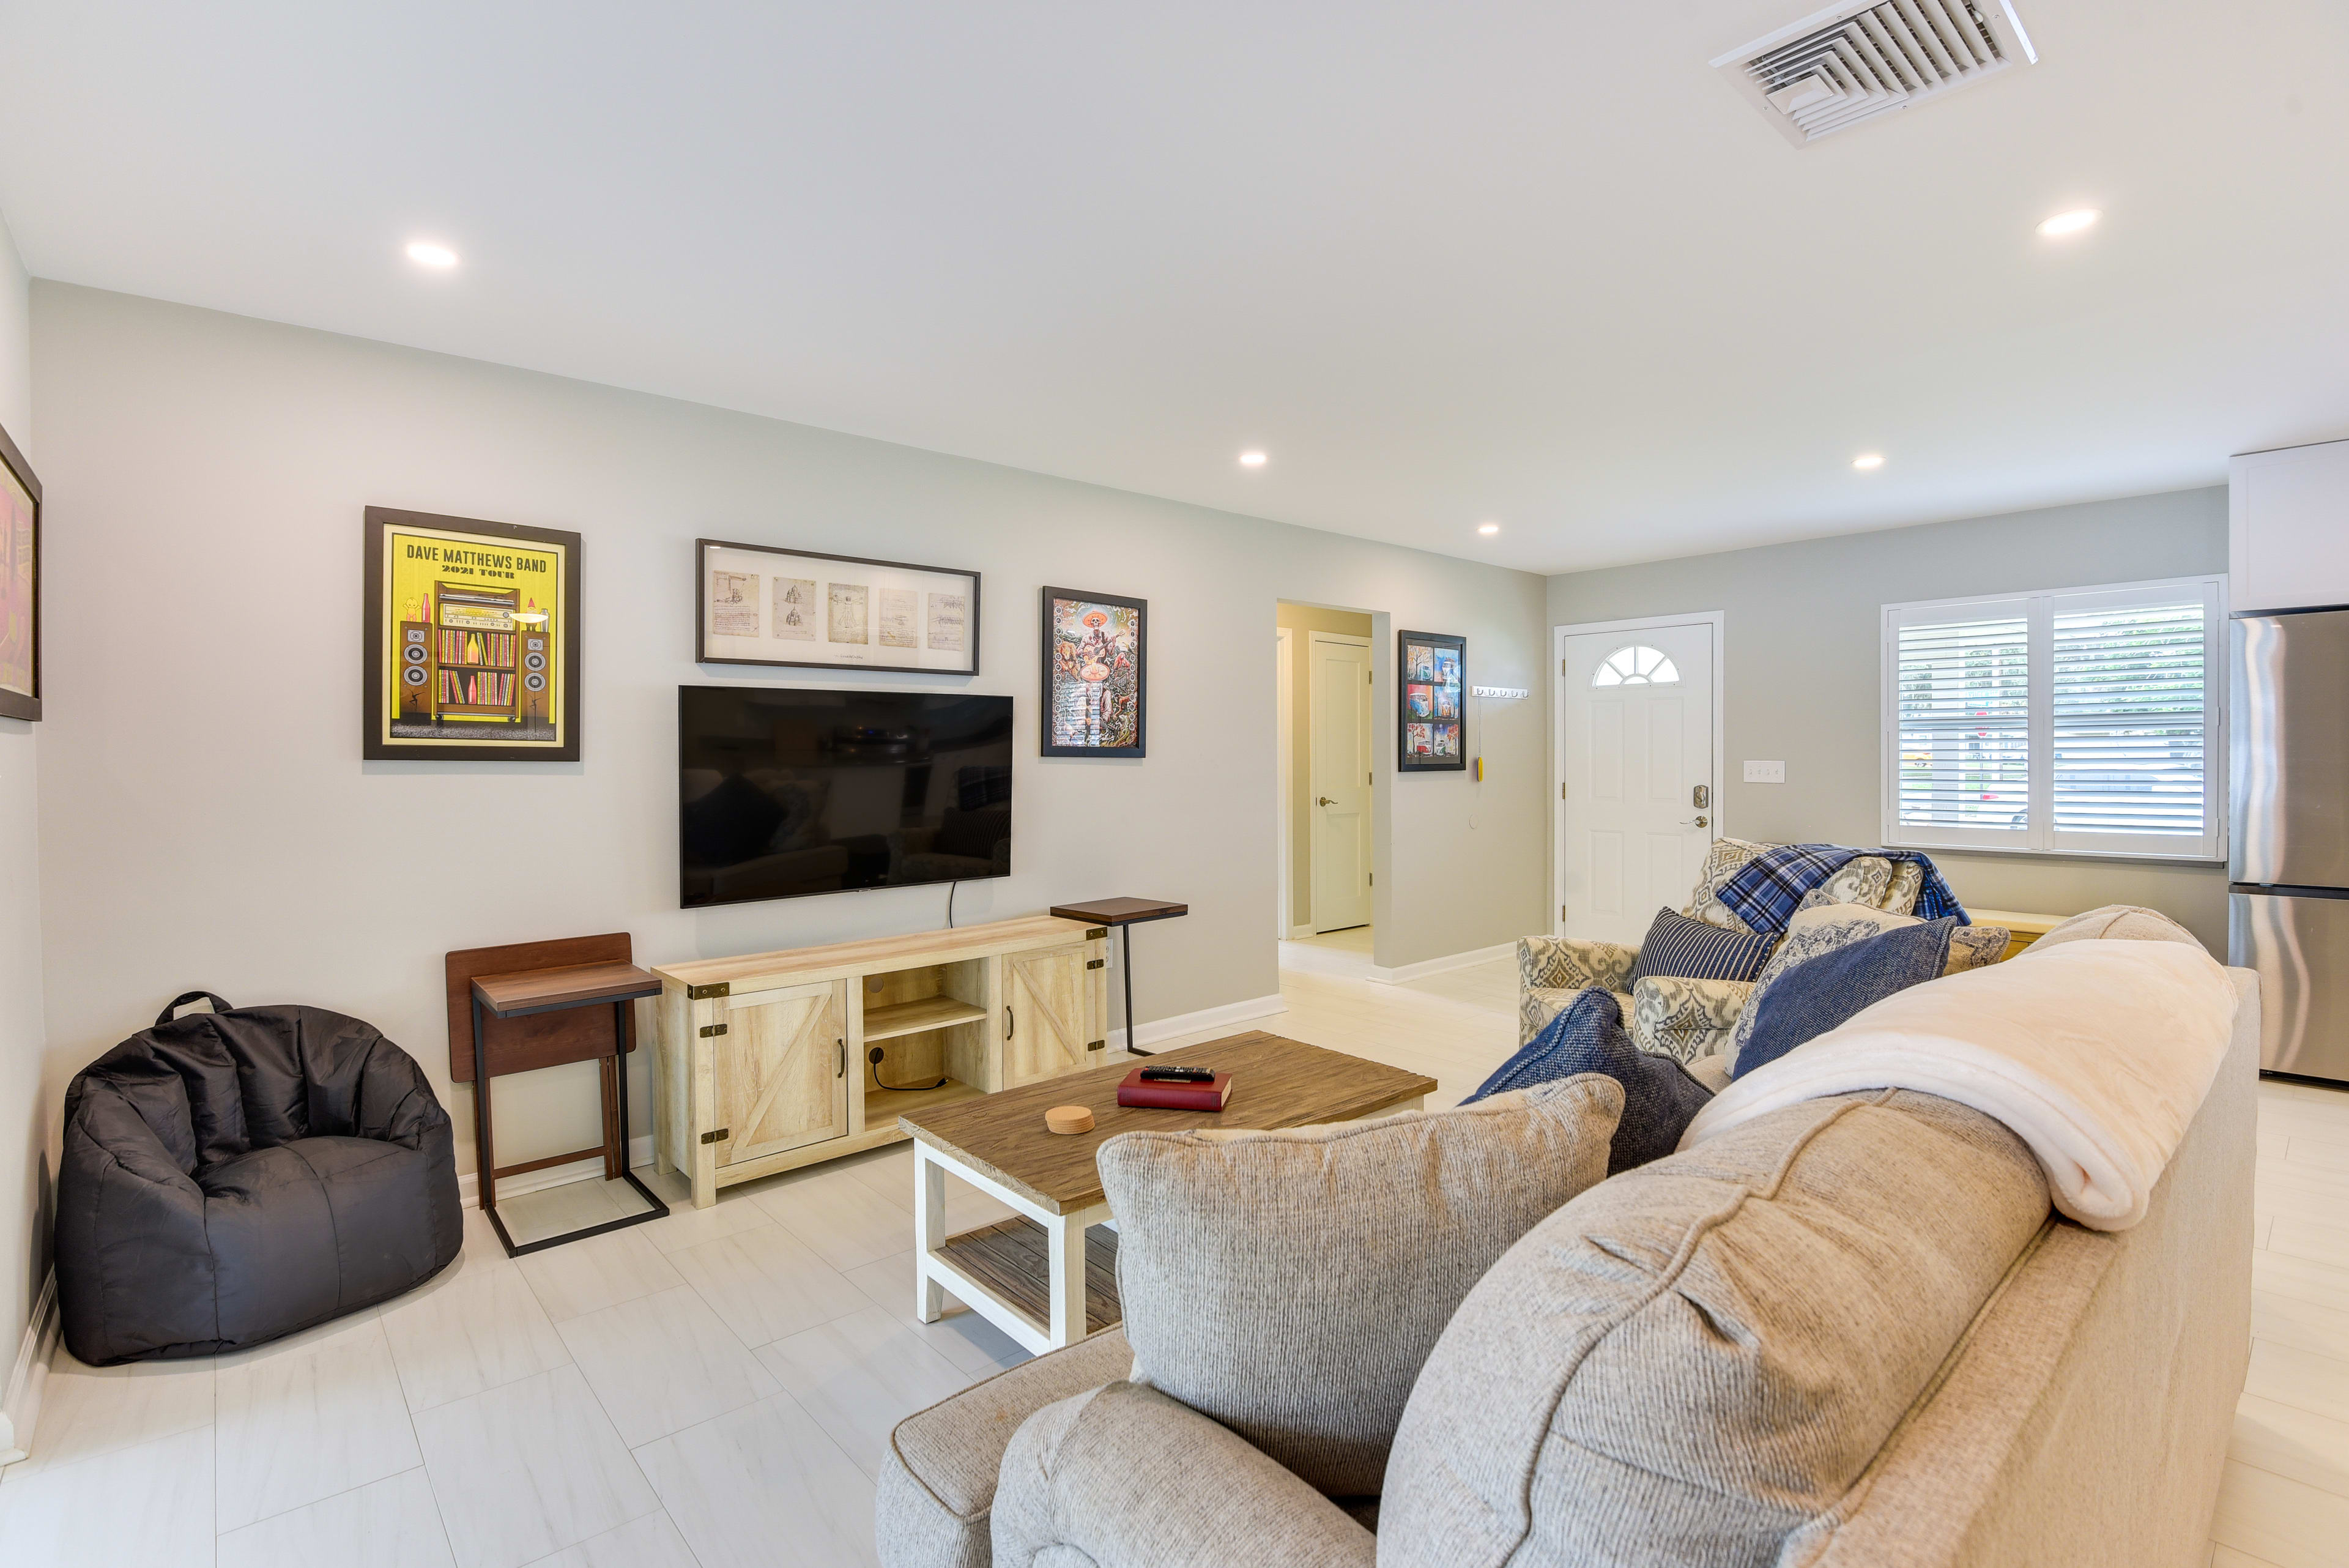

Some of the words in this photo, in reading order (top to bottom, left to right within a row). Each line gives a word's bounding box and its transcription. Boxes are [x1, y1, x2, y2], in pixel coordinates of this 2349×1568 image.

[407, 544, 439, 561] DAVE
[443, 549, 512, 569] MATTHEWS
[517, 557, 546, 573] BAND
[442, 565, 473, 574] 2021
[479, 569, 514, 579] TOUR
